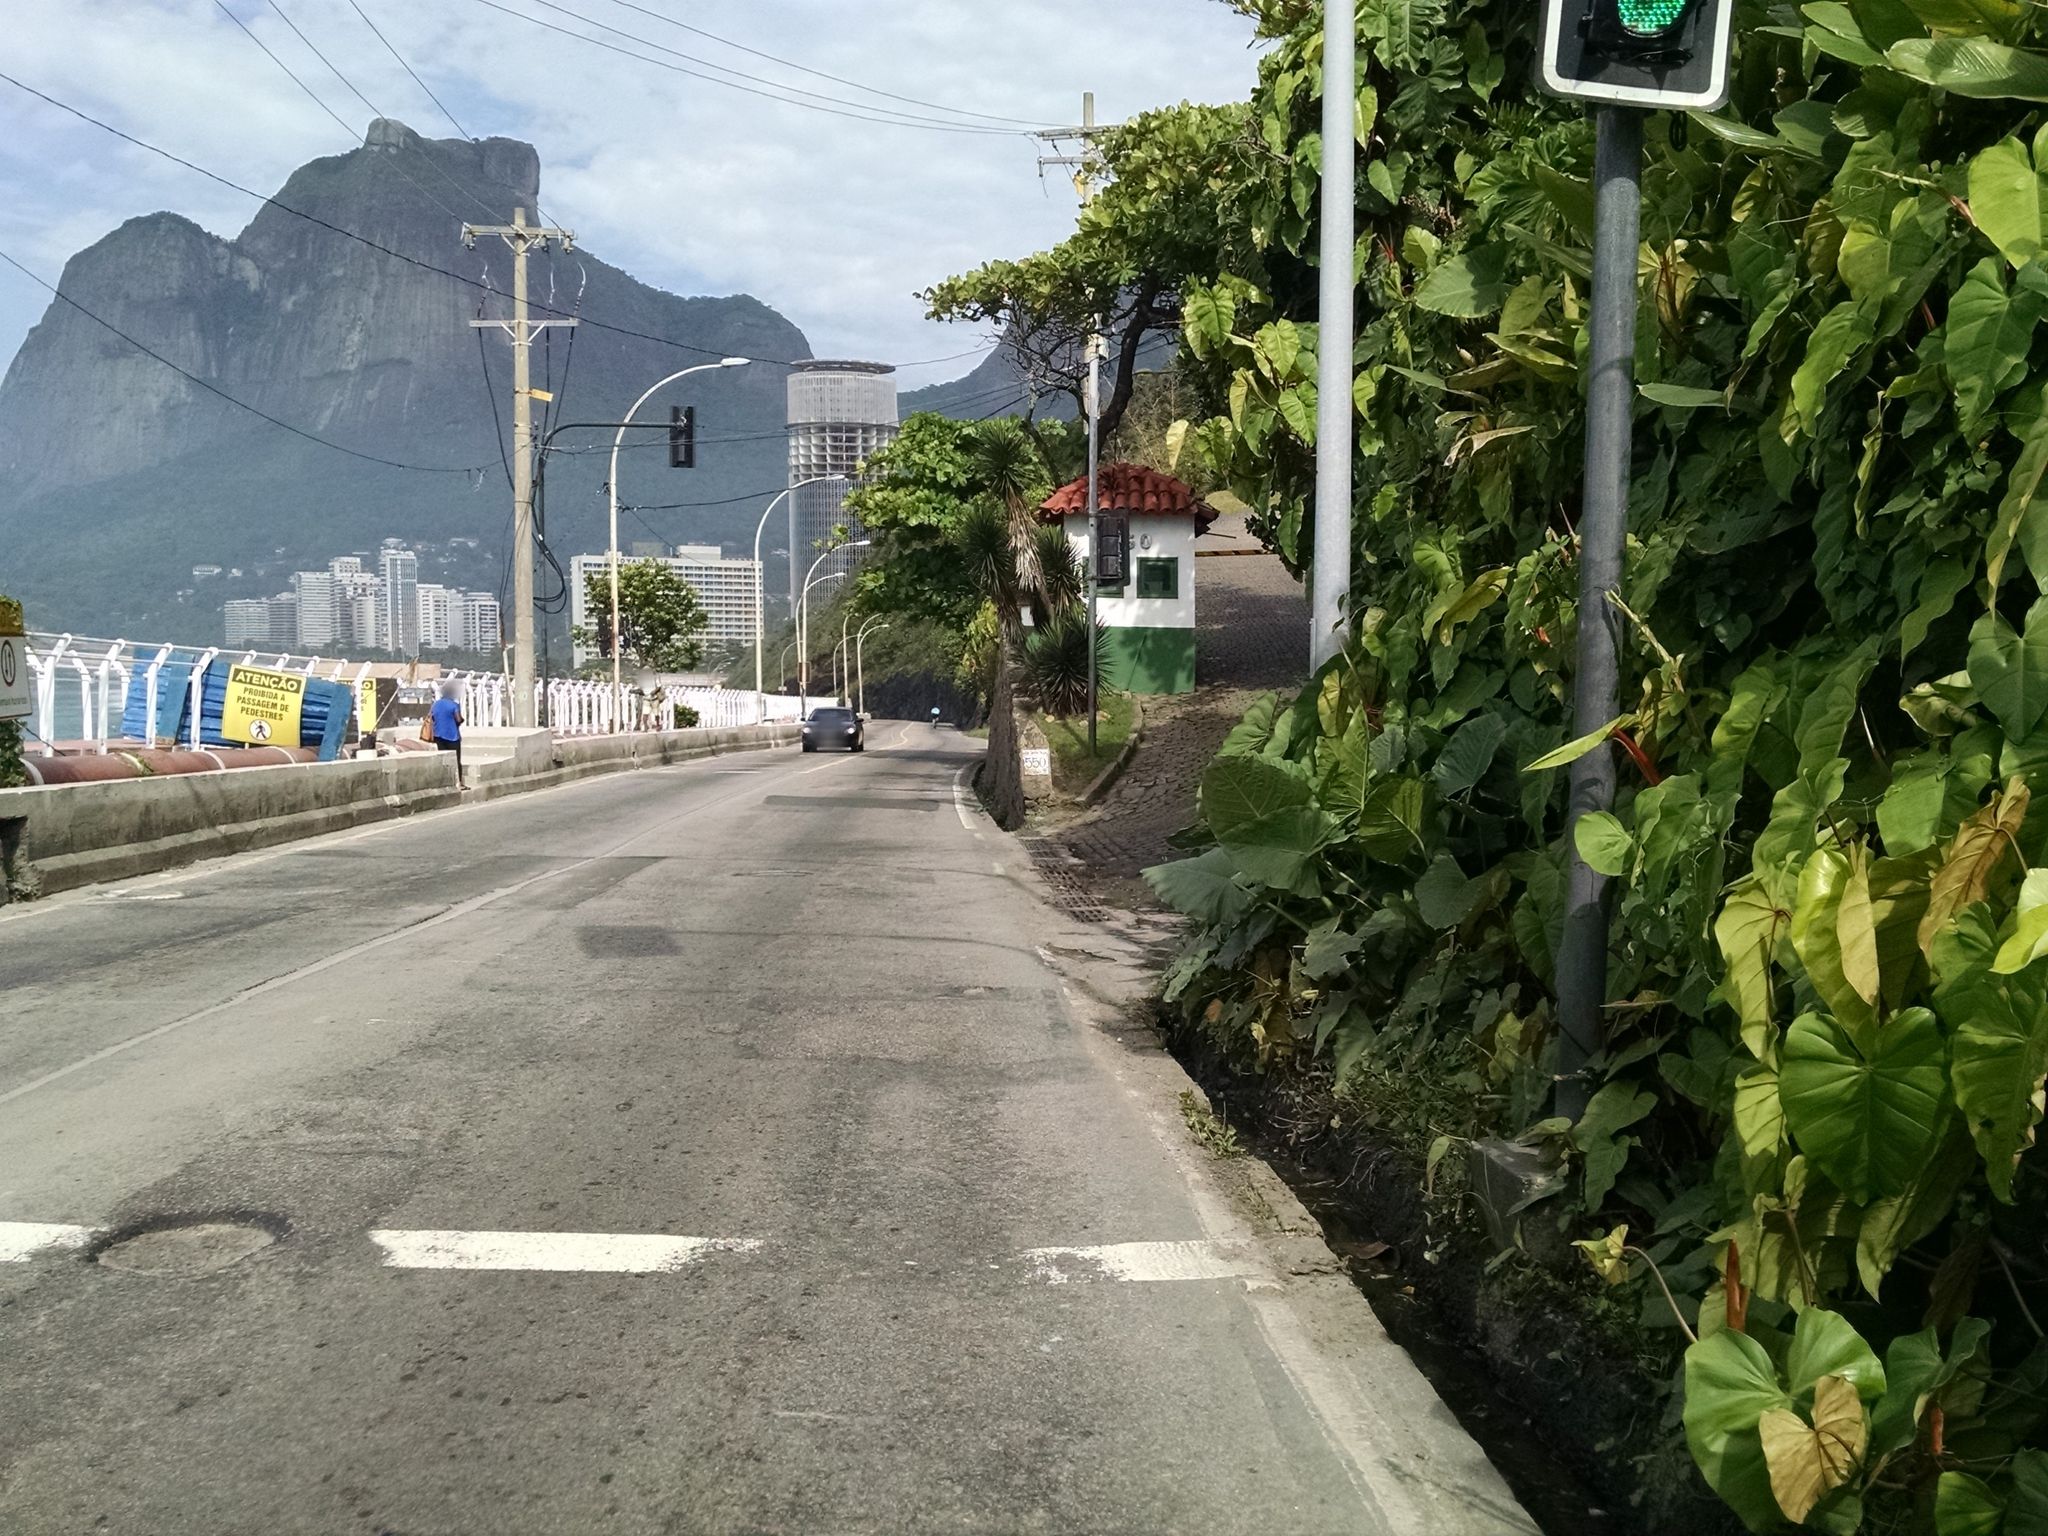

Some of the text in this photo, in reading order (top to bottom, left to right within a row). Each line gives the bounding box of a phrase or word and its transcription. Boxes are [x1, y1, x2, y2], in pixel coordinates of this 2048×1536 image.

[236, 671, 298, 691] ATENÇÃO
[243, 687, 278, 699] PROIBIDA
[237, 696, 289, 712] PASSAGEM DE
[240, 706, 284, 721] PEDESTRES
